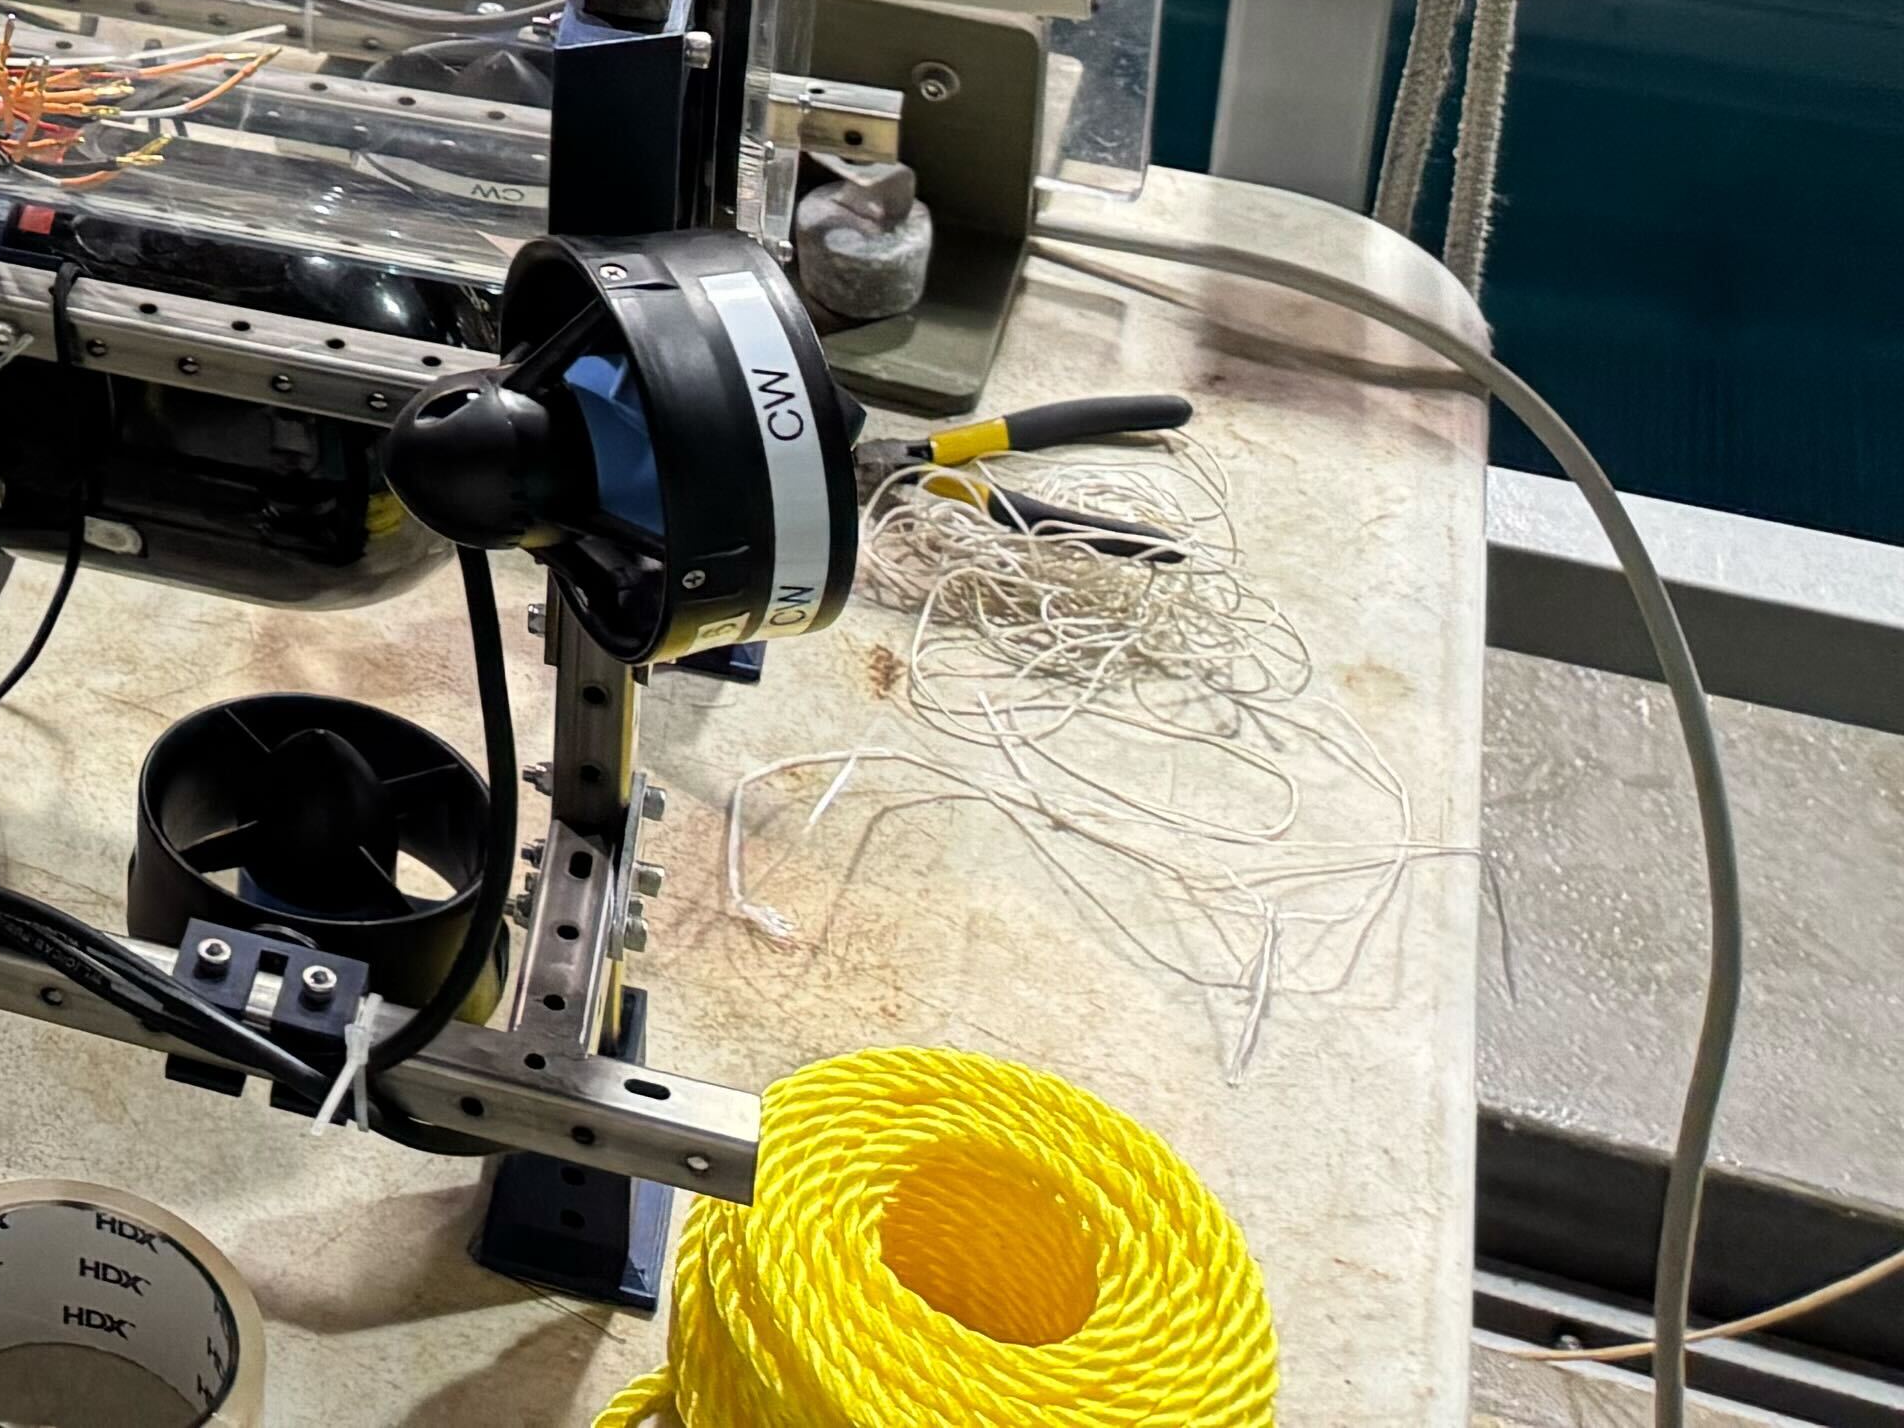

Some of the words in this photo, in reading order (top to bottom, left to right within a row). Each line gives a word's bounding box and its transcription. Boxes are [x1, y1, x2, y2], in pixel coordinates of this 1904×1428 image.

[471, 184, 525, 203] CW
[751, 368, 804, 441] CW
[769, 586, 815, 626] CW
[95, 1211, 160, 1255] HDX
